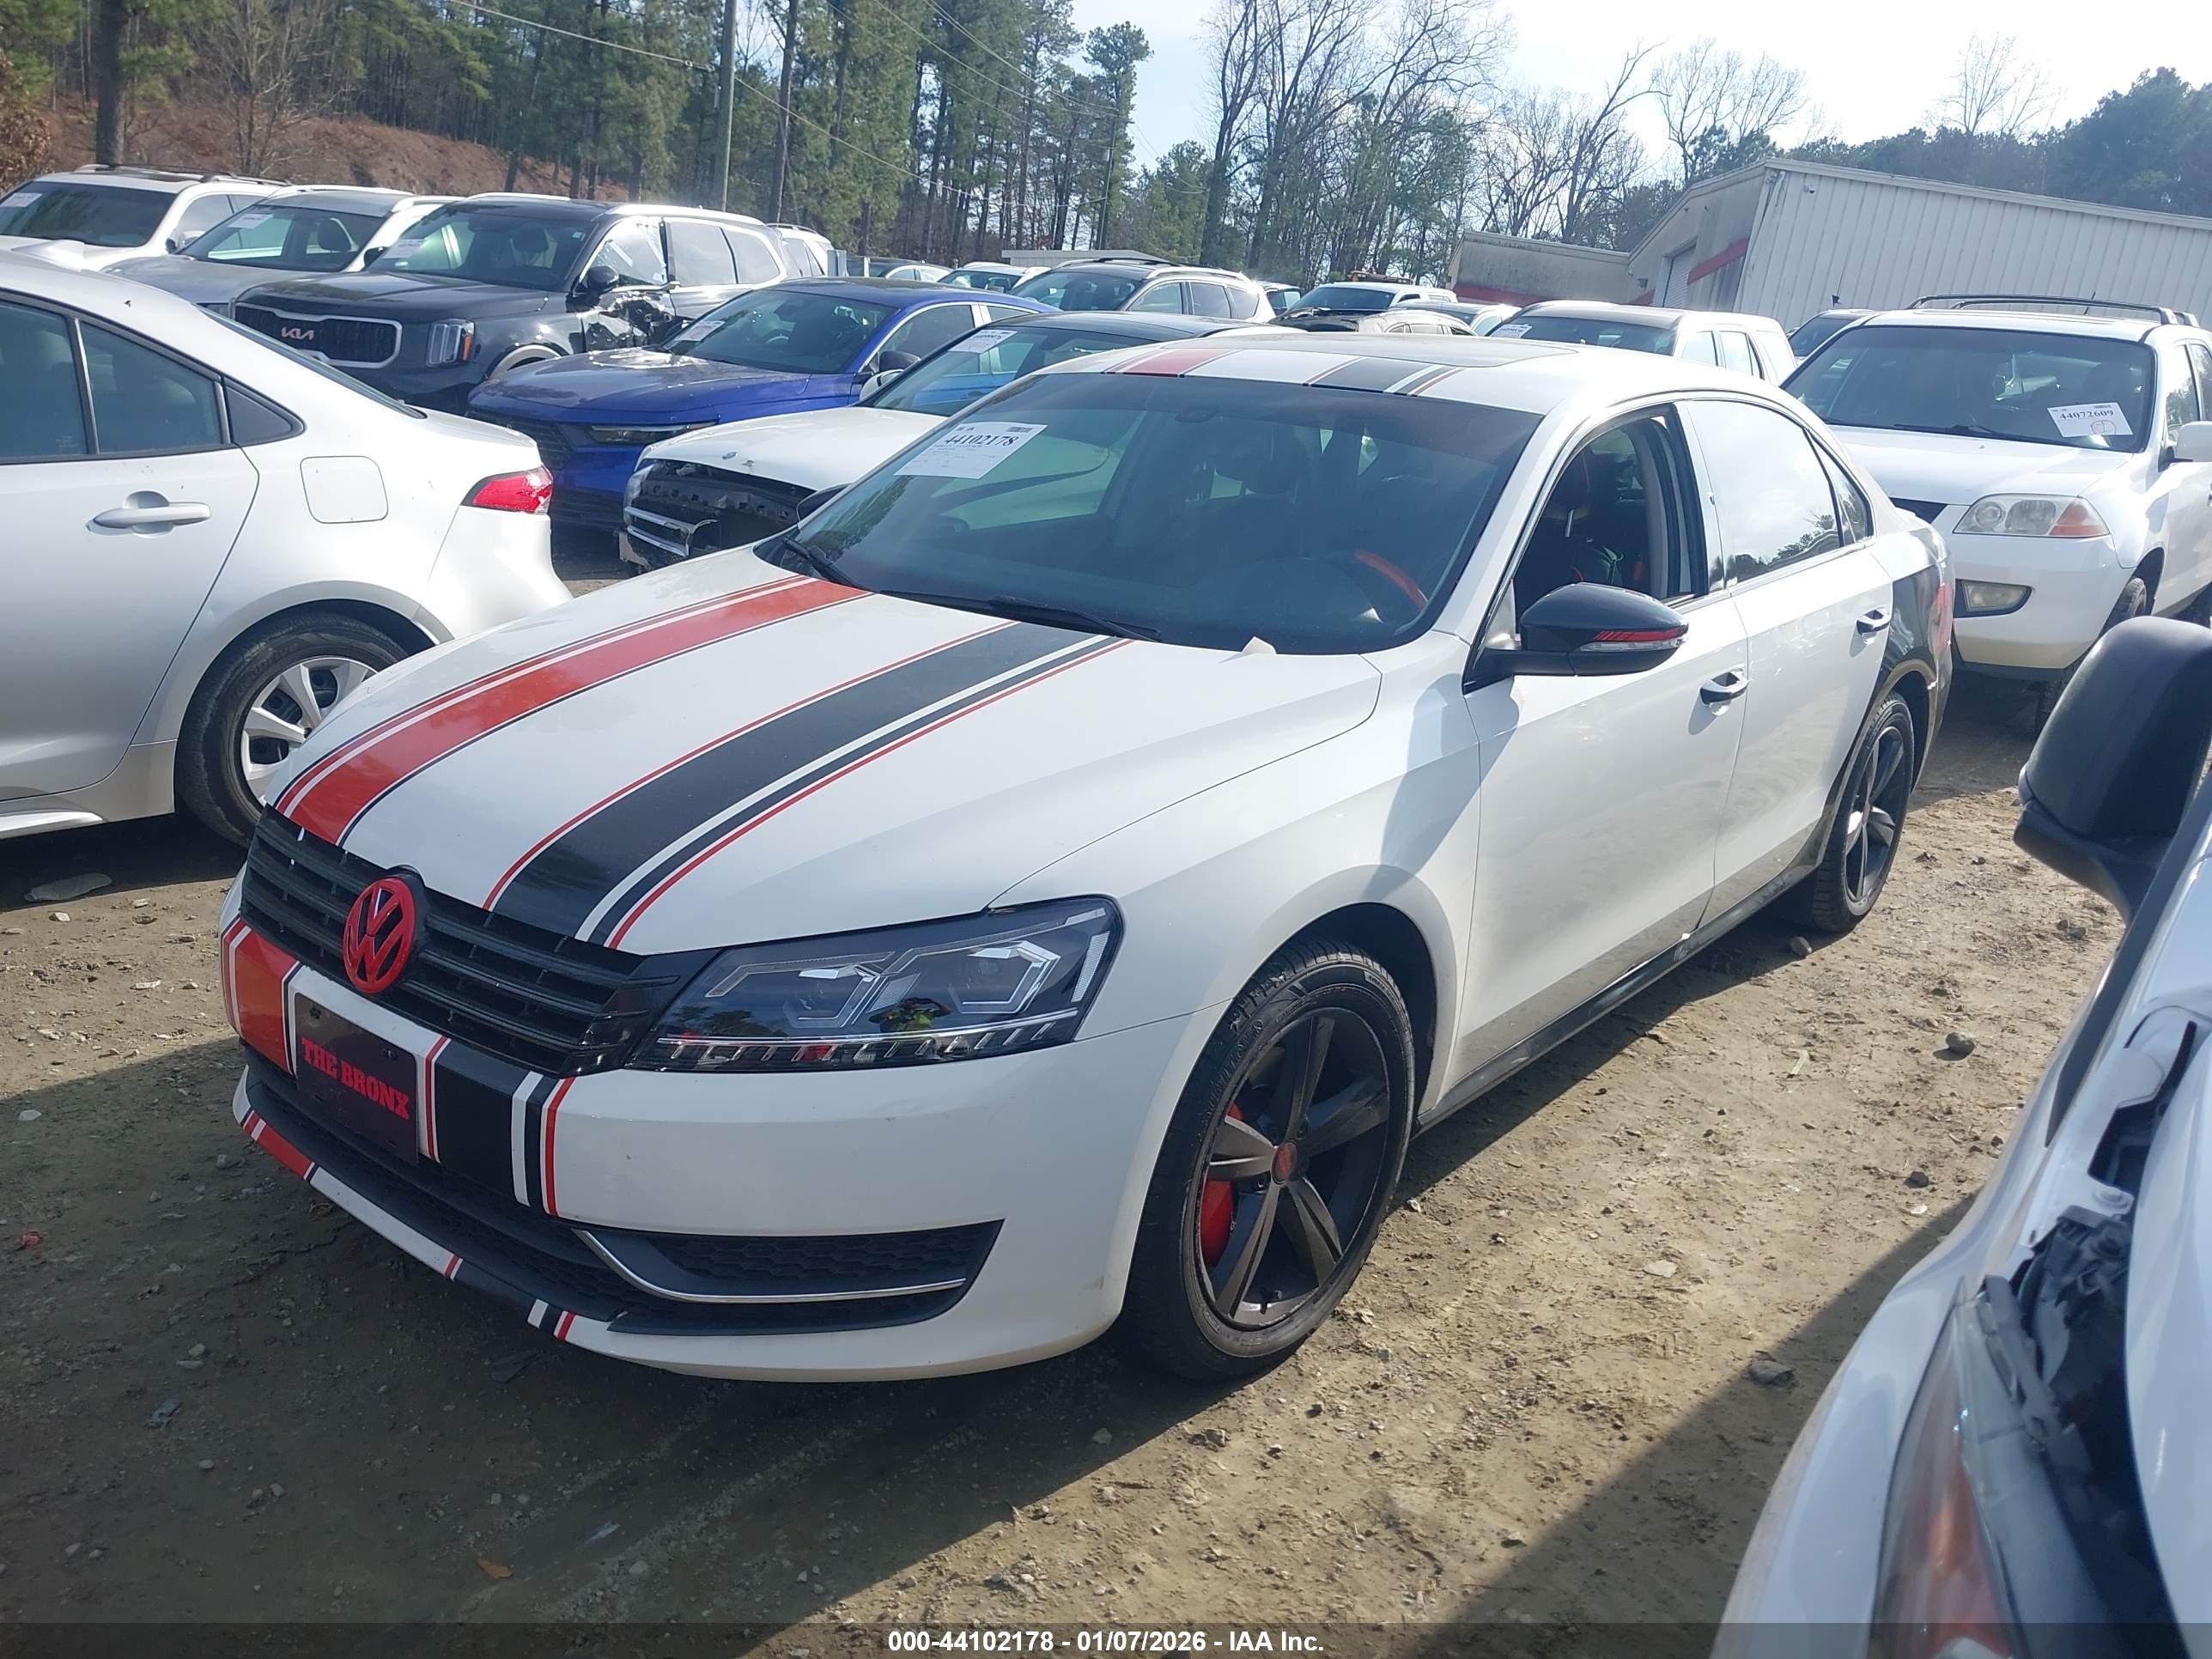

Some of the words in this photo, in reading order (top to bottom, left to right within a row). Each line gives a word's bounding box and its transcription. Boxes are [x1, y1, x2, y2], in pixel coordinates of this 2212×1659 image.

[282, 327, 314, 340] KIA
[945, 434, 1019, 447] 44102178
[301, 1036, 338, 1079] THE
[340, 1060, 410, 1121] BRONX
